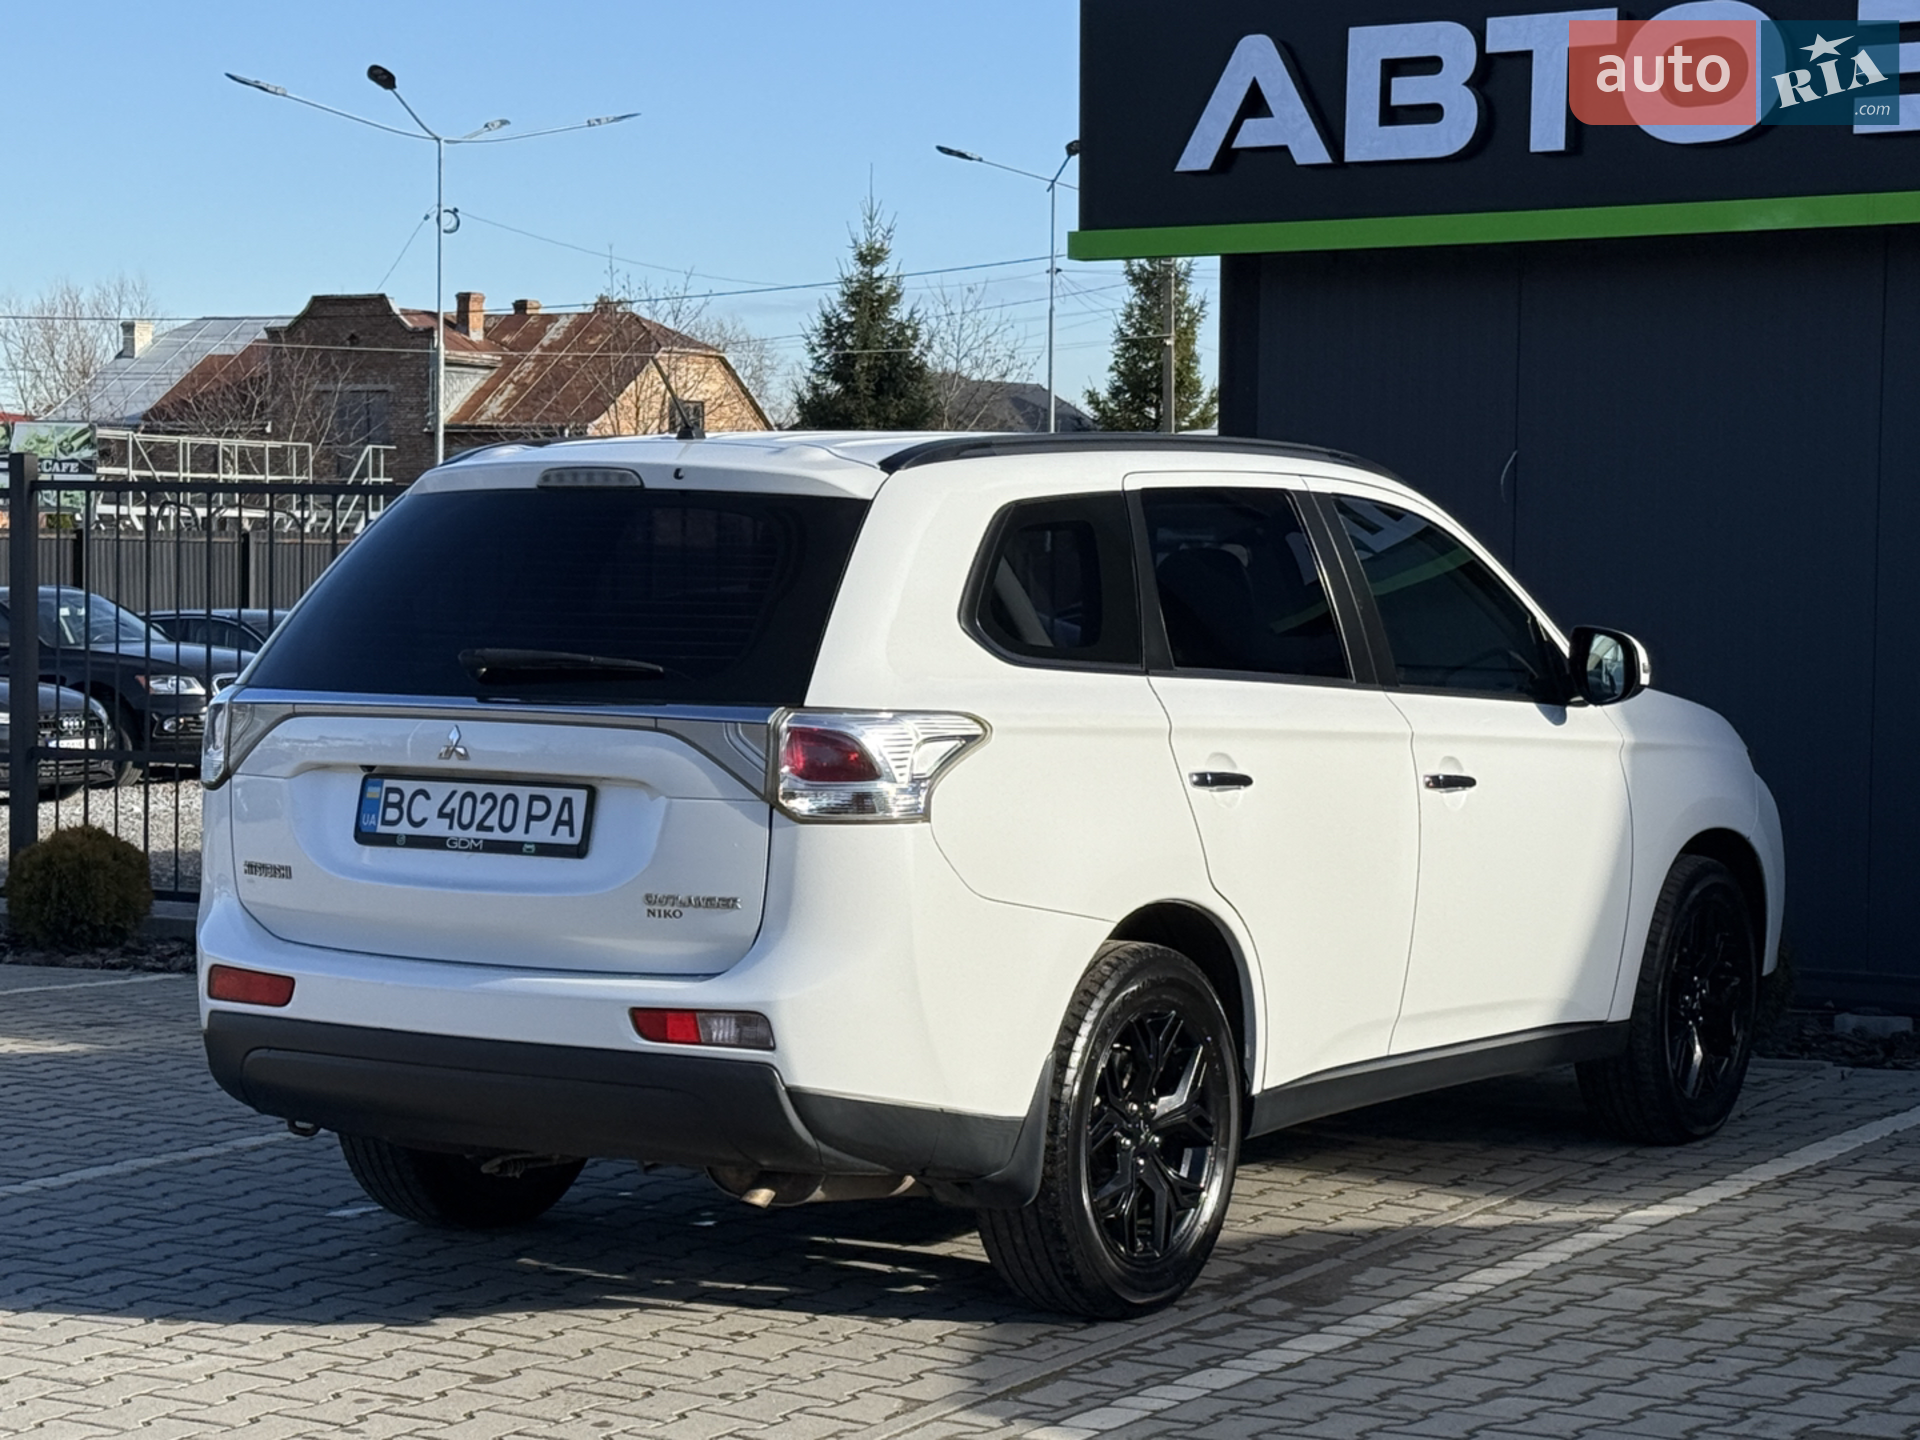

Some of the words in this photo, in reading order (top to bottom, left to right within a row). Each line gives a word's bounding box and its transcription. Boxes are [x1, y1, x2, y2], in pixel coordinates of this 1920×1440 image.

[41, 459, 79, 473] CAFE
[380, 786, 431, 828] BC
[437, 790, 519, 833] 4020
[524, 794, 576, 838] PA
[362, 812, 377, 827] UA
[446, 837, 483, 850] GDM
[646, 908, 683, 919] NIKO
